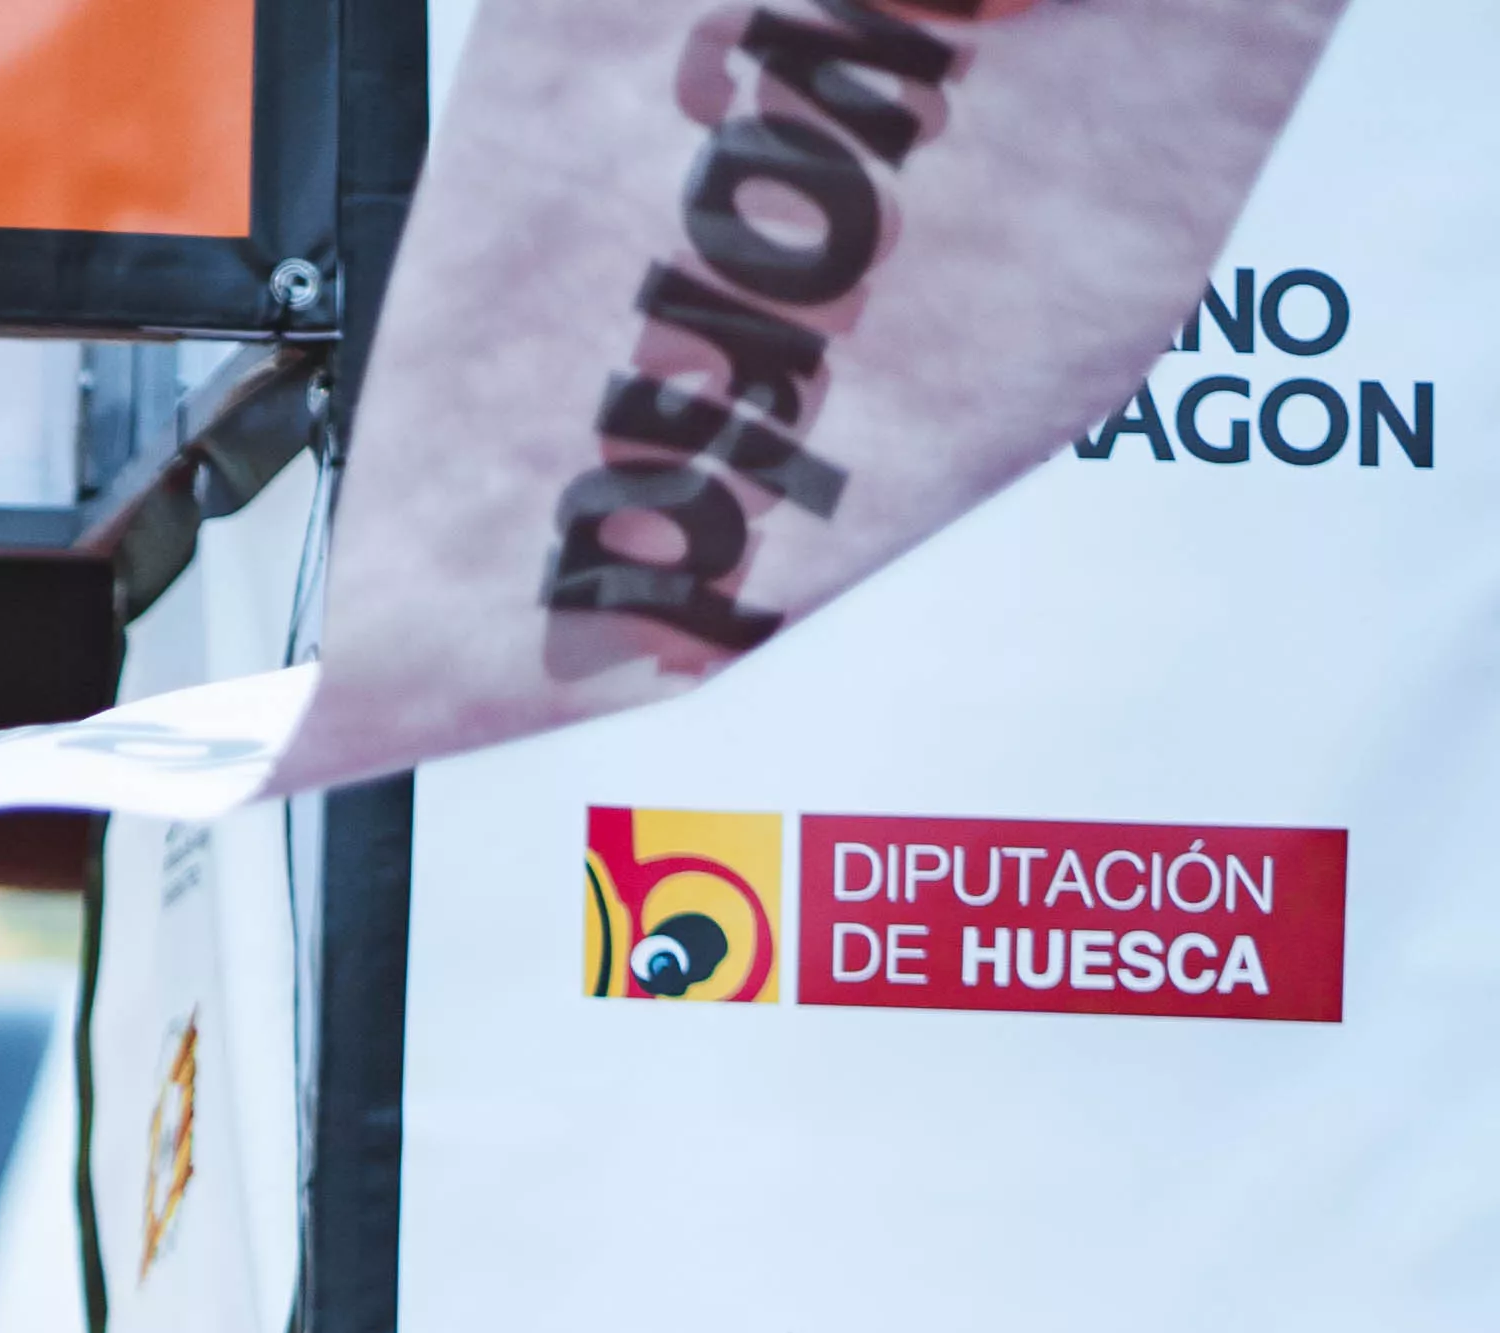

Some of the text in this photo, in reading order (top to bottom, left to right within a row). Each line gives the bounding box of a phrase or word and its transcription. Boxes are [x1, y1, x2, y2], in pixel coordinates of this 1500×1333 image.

[1060, 374, 1434, 469] AGON
[832, 838, 1275, 914] DIPUTACIÓN
[832, 922, 1269, 995] DE HUESCA
